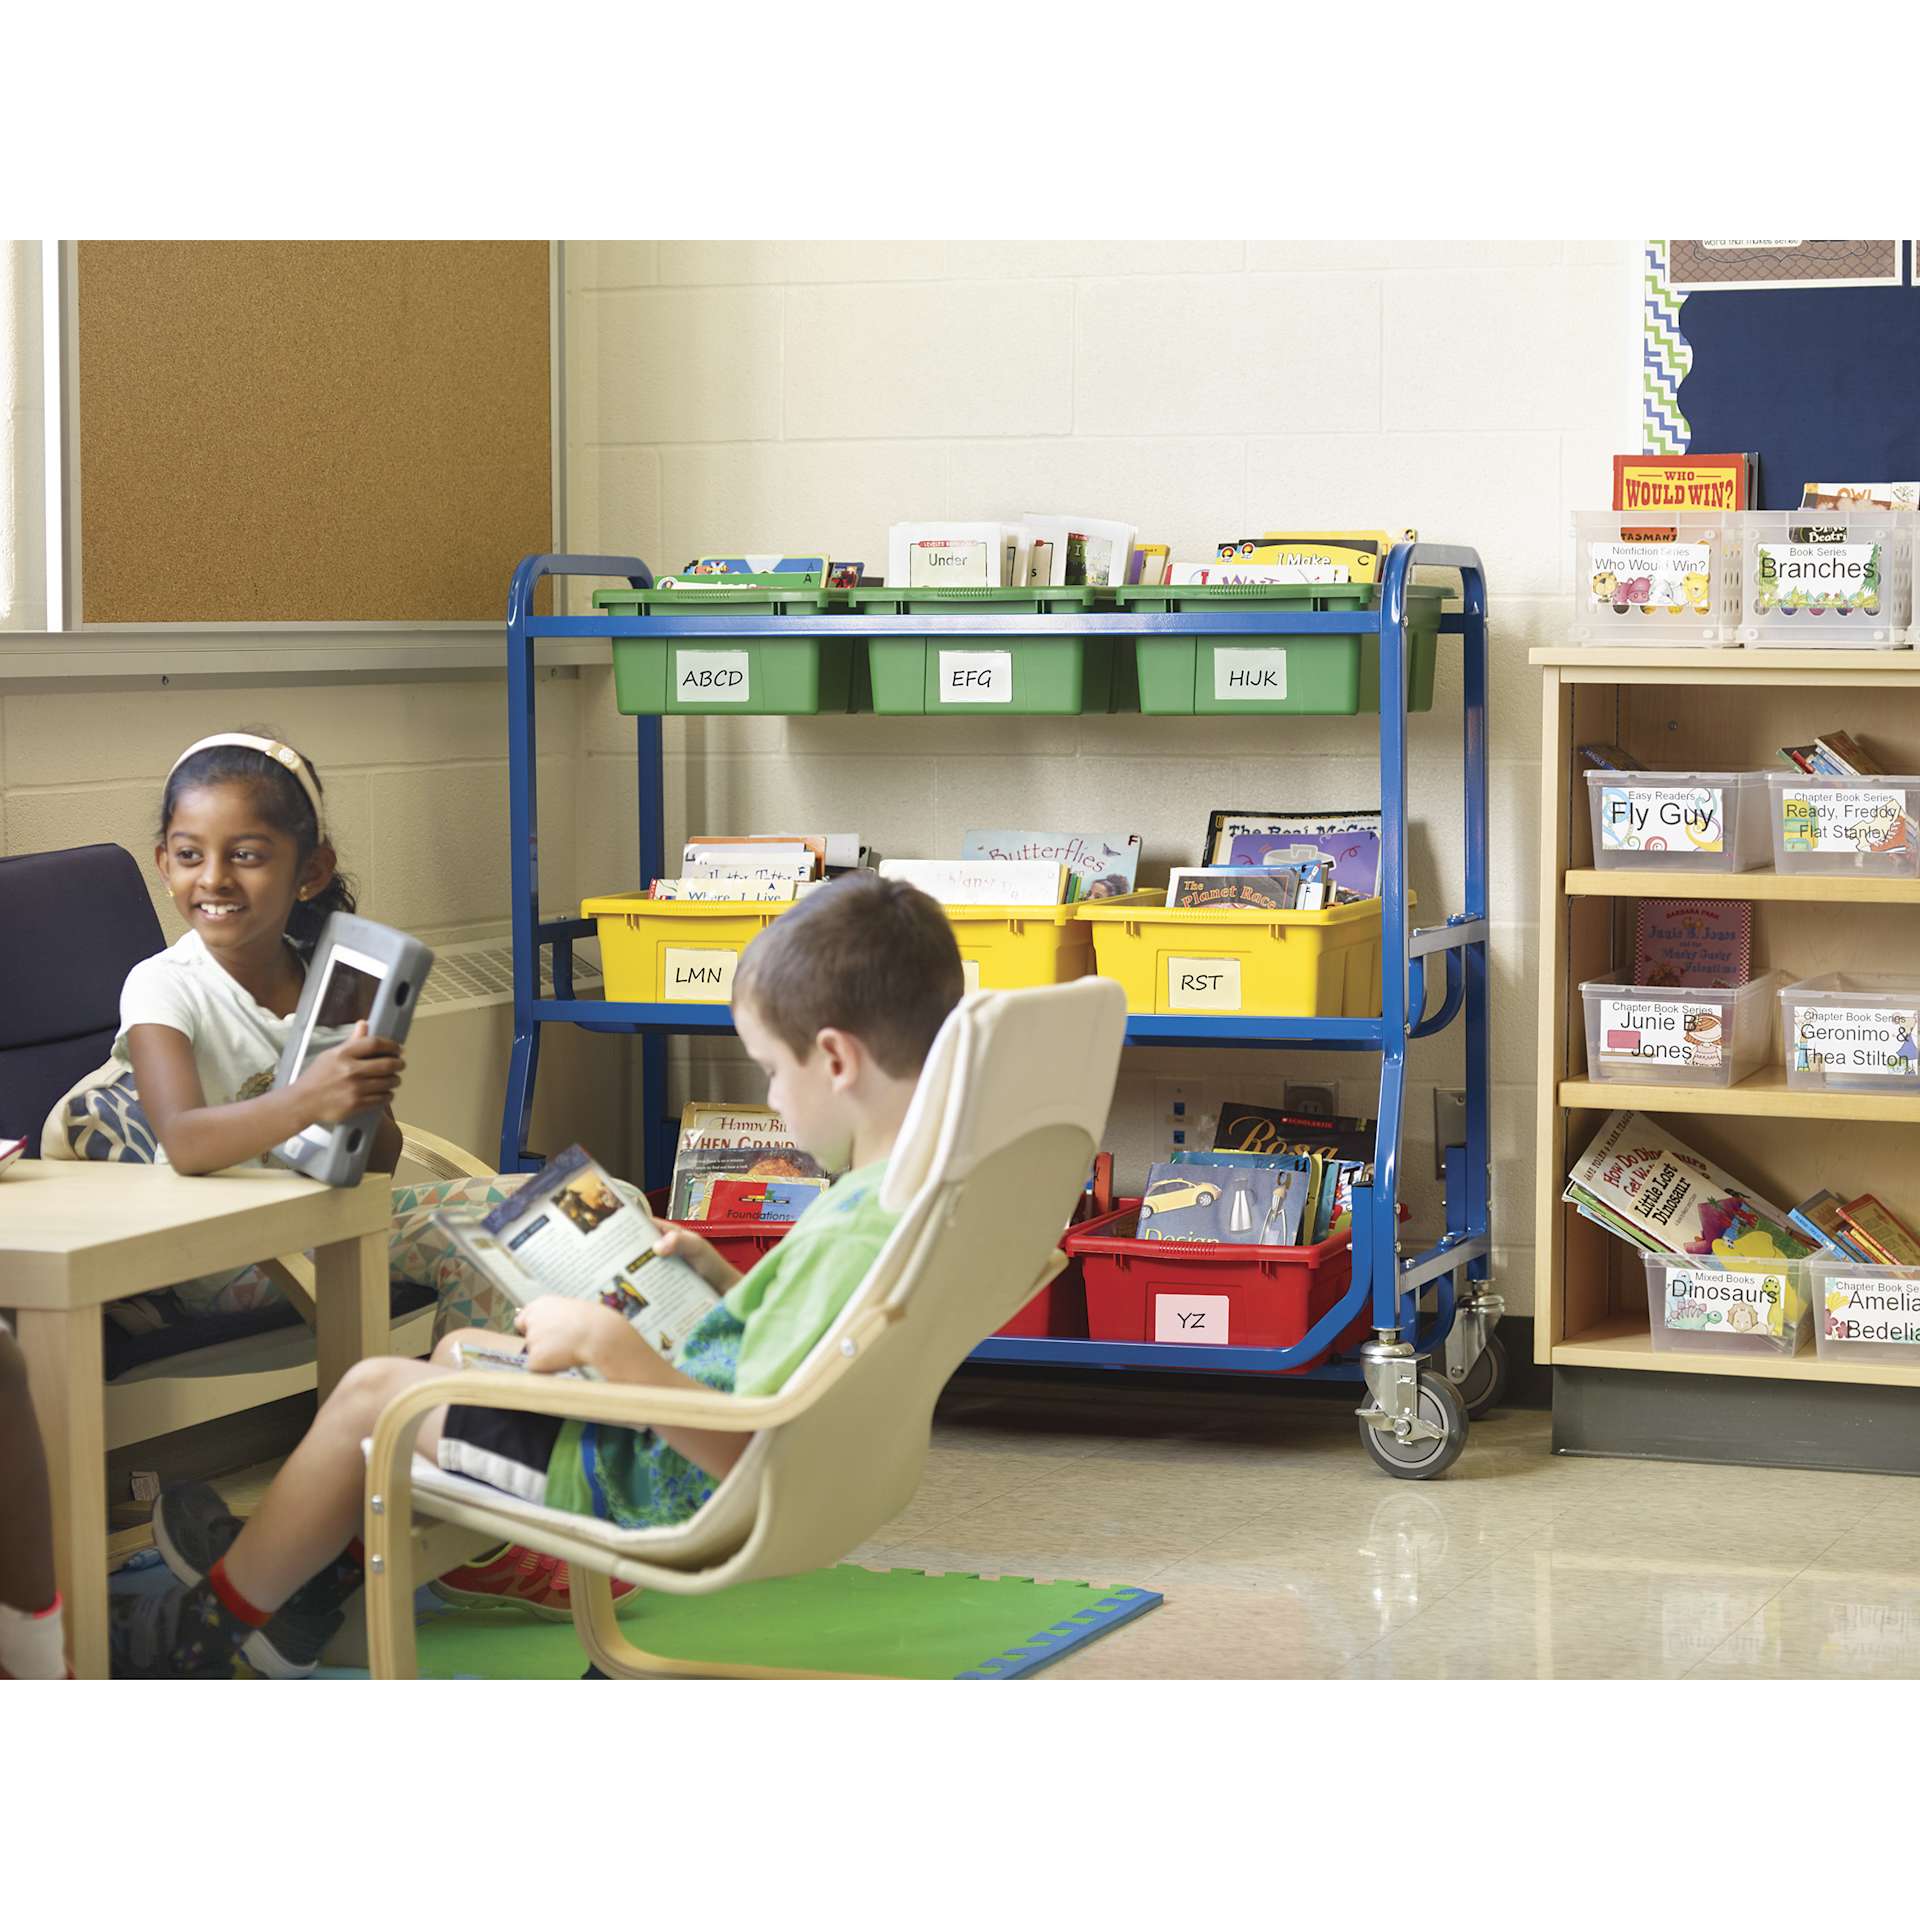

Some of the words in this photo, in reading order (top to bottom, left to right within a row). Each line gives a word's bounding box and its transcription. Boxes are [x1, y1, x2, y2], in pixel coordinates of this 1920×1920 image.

[1664, 471, 1695, 480] WHO
[1626, 479, 1685, 508] WOULD
[1688, 480, 1734, 509] WIN?
[1613, 547, 1658, 555] Nonfiction
[1790, 548, 1813, 557] Book
[1817, 548, 1847, 556] Series
[929, 553, 968, 566] Under
[1287, 553, 1331, 566] Make
[1595, 559, 1625, 570] Who
[1673, 560, 1706, 571] Win?
[1762, 557, 1875, 579] Branches
[682, 670, 743, 687] ABCD
[951, 670, 992, 687] EFG
[1229, 670, 1278, 687] HIJK
[1628, 791, 1652, 801] Easy
[1655, 791, 1695, 800] Readers
[1794, 793, 1832, 803] Chapter
[1836, 793, 1861, 802] Book
[1863, 793, 1894, 802] Series
[1612, 802, 1649, 831] Fly
[1660, 802, 1713, 832] Guy
[1787, 804, 1838, 820] Ready,
[1128, 835, 1138, 846] F
[1800, 825, 1827, 838] Flat
[1834, 825, 1889, 842] Stanley
[989, 838, 1105, 873] Butterflies
[1184, 880, 1204, 890] The
[1181, 885, 1237, 909] Planet
[1240, 885, 1277, 909] Race
[676, 967, 722, 983] LMN
[1181, 975, 1223, 990] RST
[1613, 1002, 1651, 1013] Chapter
[1655, 1004, 1679, 1013] Book
[1682, 1006, 1713, 1015] Series
[1621, 1011, 1675, 1030] Junie
[1804, 1011, 1843, 1023] Chapter
[1847, 1012, 1871, 1021] Book
[1801, 1024, 1890, 1042] Geronimo
[1897, 1027, 1909, 1042] &
[1632, 1040, 1692, 1059] Jones
[1800, 1048, 1846, 1064] Thea
[1853, 1050, 1908, 1069] Stilton
[1603, 1163, 1625, 1188] How
[1616, 1152, 1639, 1168] Do
[1634, 1185, 1664, 1218] Little
[1652, 1162, 1679, 1190] Lost
[1652, 1177, 1691, 1226] Dinosaur
[1696, 1272, 1723, 1281] Mixed
[1727, 1274, 1756, 1284] Books
[1672, 1279, 1778, 1304] Dinosaurs
[1836, 1281, 1874, 1291] Chapter
[1878, 1283, 1902, 1292] Book
[1177, 1313, 1206, 1329] YZ
